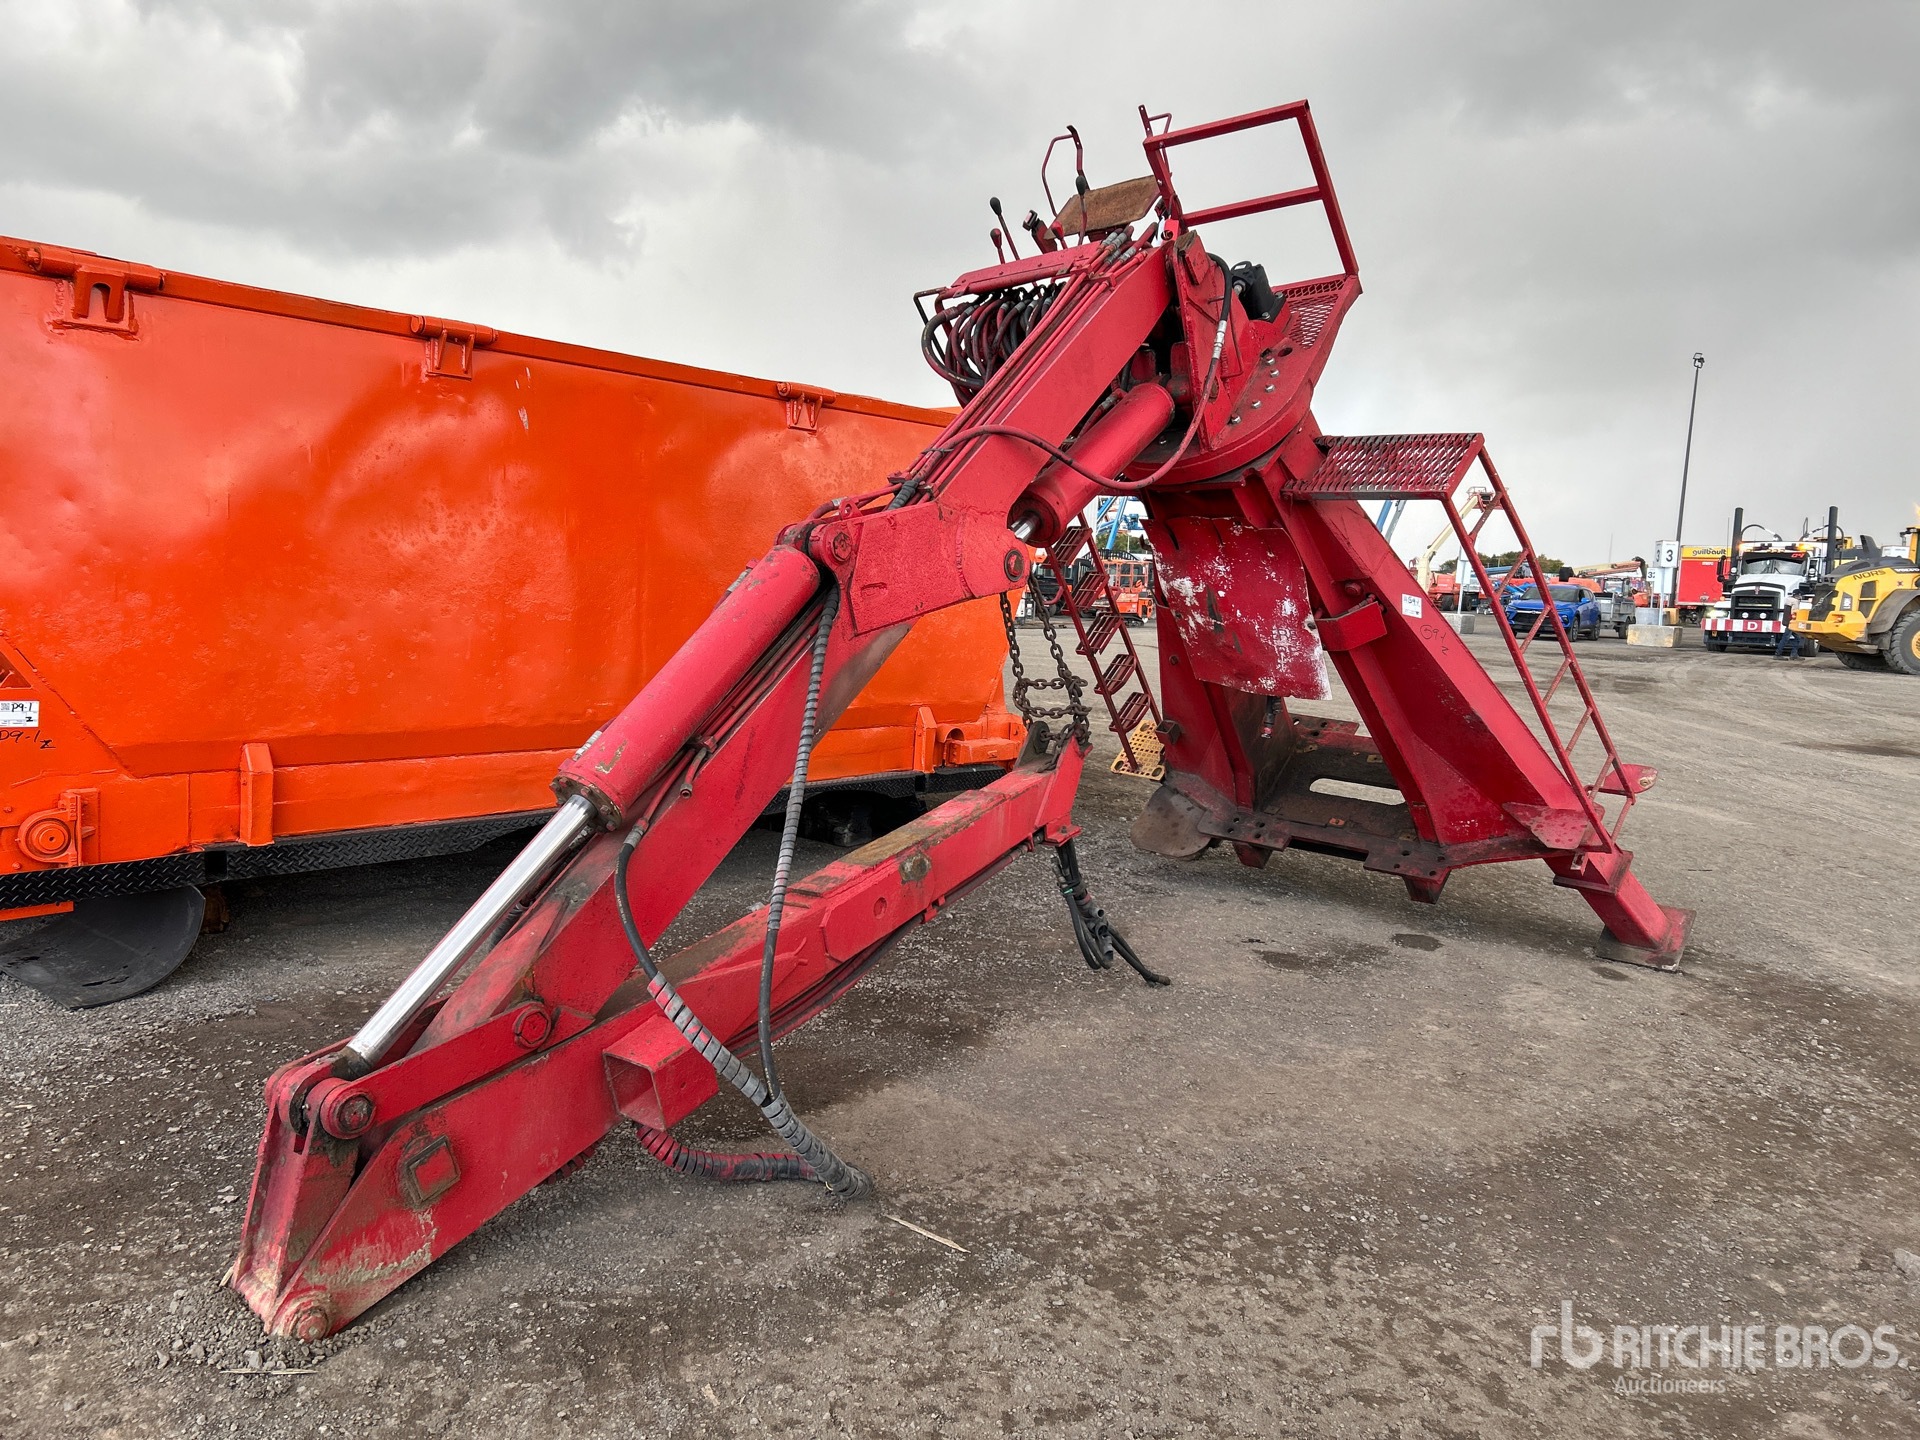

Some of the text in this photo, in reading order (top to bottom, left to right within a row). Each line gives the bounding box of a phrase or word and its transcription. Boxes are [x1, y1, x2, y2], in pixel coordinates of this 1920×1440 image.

[1666, 549, 1674, 562] 3
[1692, 548, 1726, 556] guilbault
[1853, 569, 1886, 580] NORS
[1747, 621, 1758, 631] D
